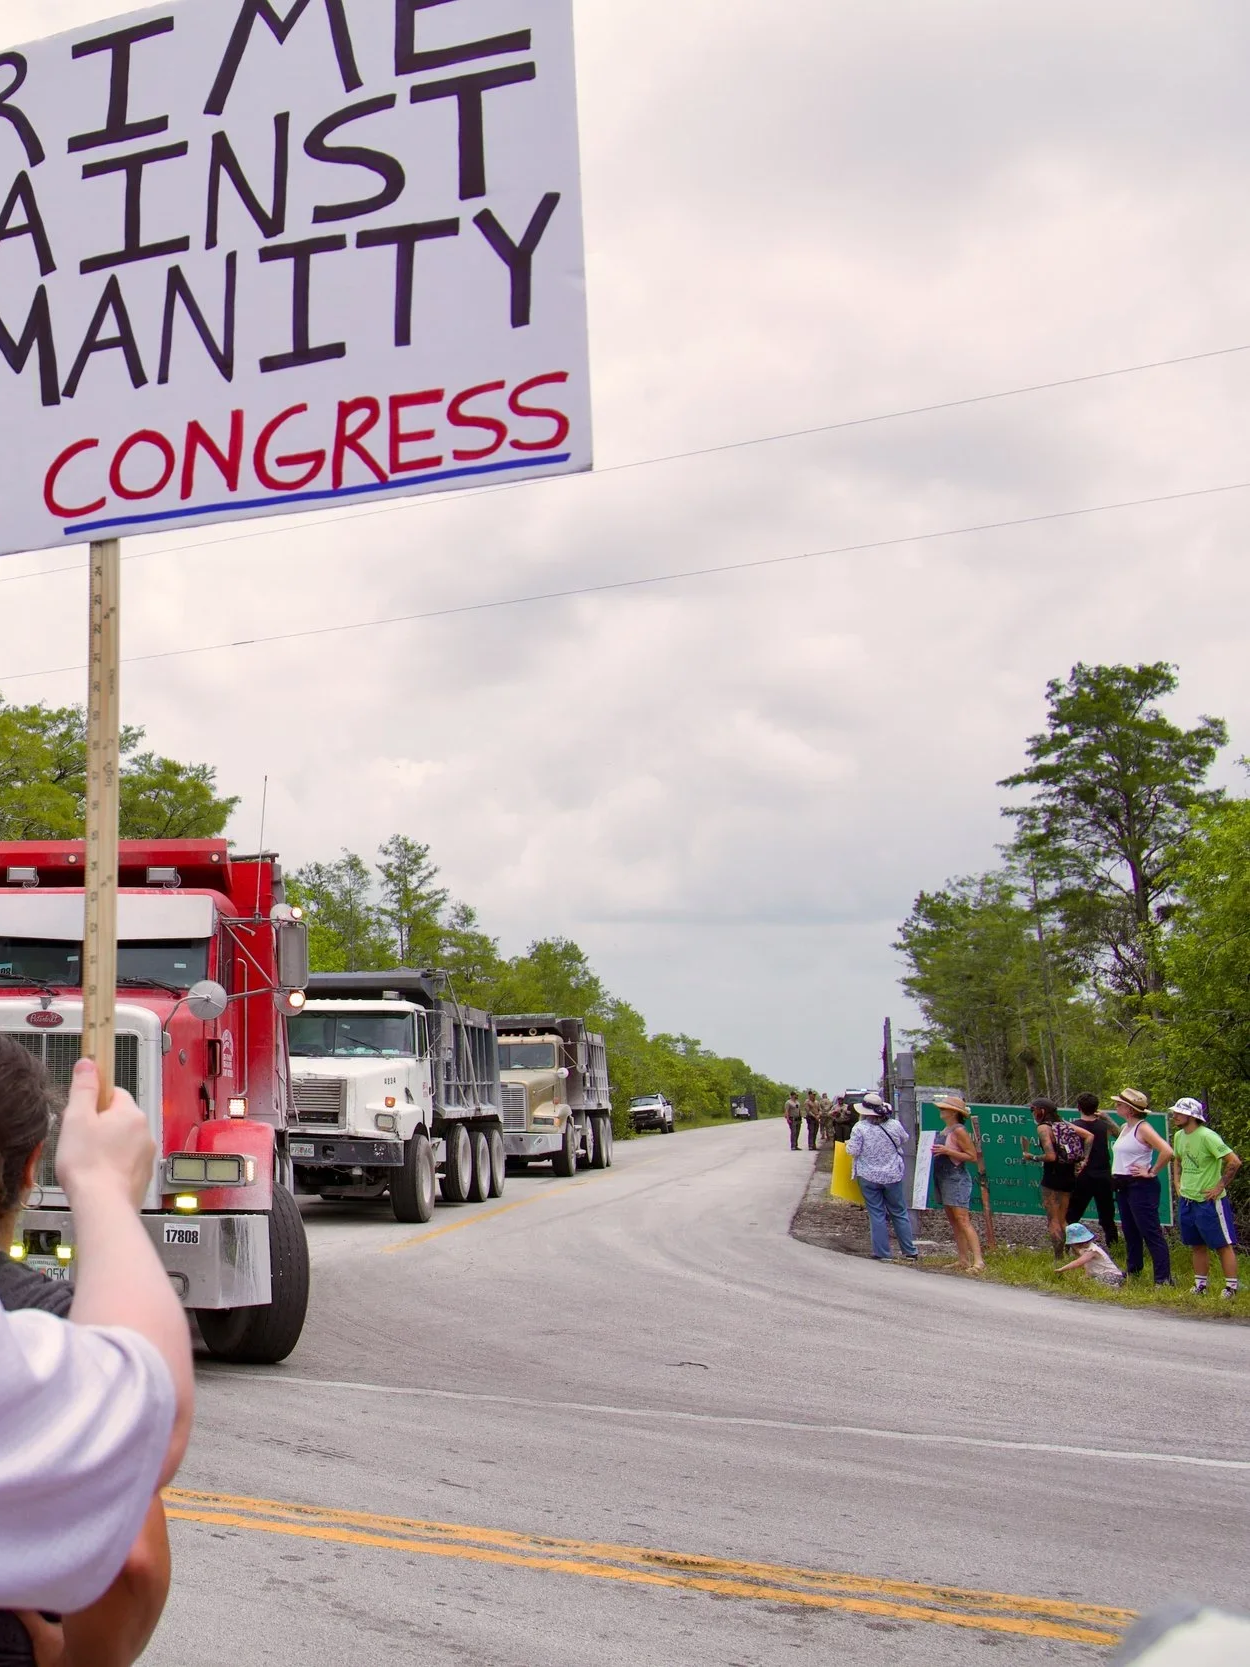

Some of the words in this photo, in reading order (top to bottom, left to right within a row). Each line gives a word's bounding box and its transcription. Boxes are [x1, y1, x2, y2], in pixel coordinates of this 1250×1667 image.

[43, 370, 570, 518] CONGRESS
[996, 1134, 1006, 1144] &
[165, 1229, 199, 1244] 17808
